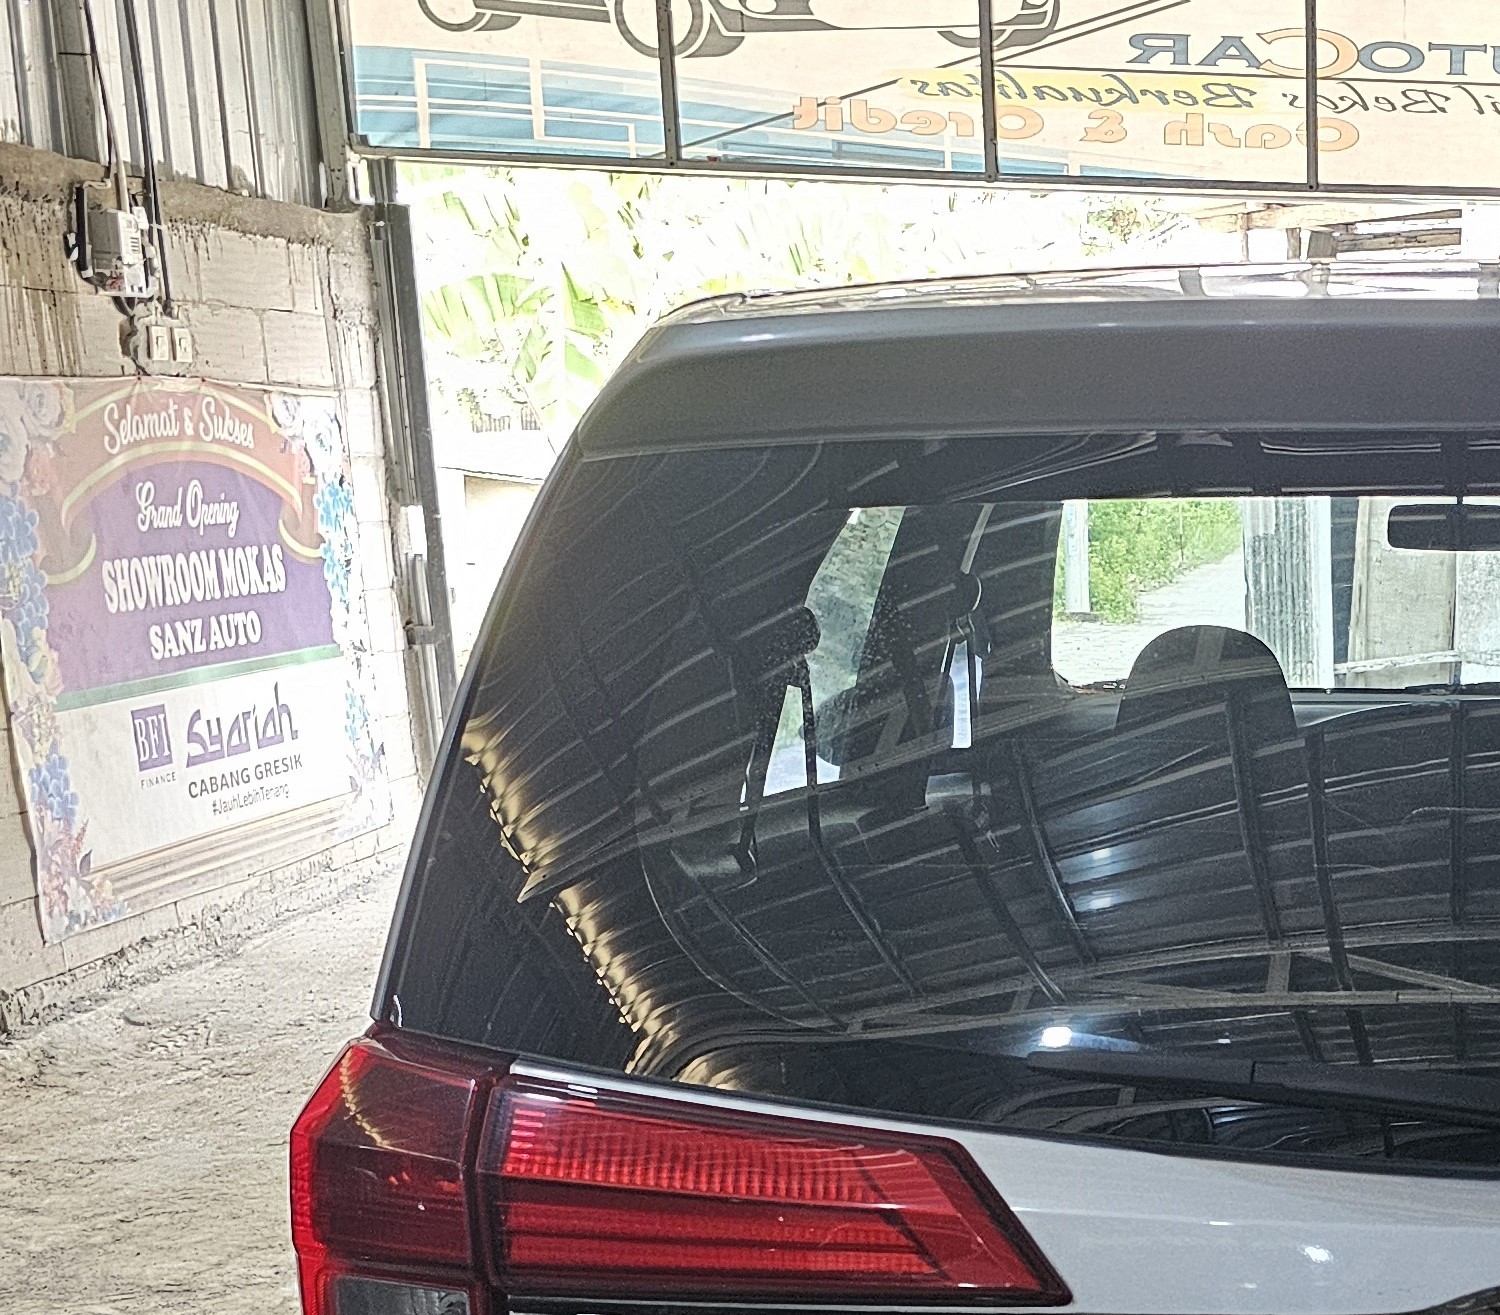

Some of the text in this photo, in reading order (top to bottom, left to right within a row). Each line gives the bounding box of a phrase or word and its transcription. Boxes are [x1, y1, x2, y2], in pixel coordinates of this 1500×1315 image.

[103, 396, 255, 454] Selamat & Sukses
[135, 479, 240, 538] Grand Opening
[102, 543, 287, 614] SHOWROOM MOKAS
[149, 610, 262, 660] SANZ AUTO
[133, 713, 171, 763] BFI
[186, 681, 299, 768] Syariah
[140, 771, 177, 790] FINANCE
[188, 753, 303, 799] CABANG GRESIK
